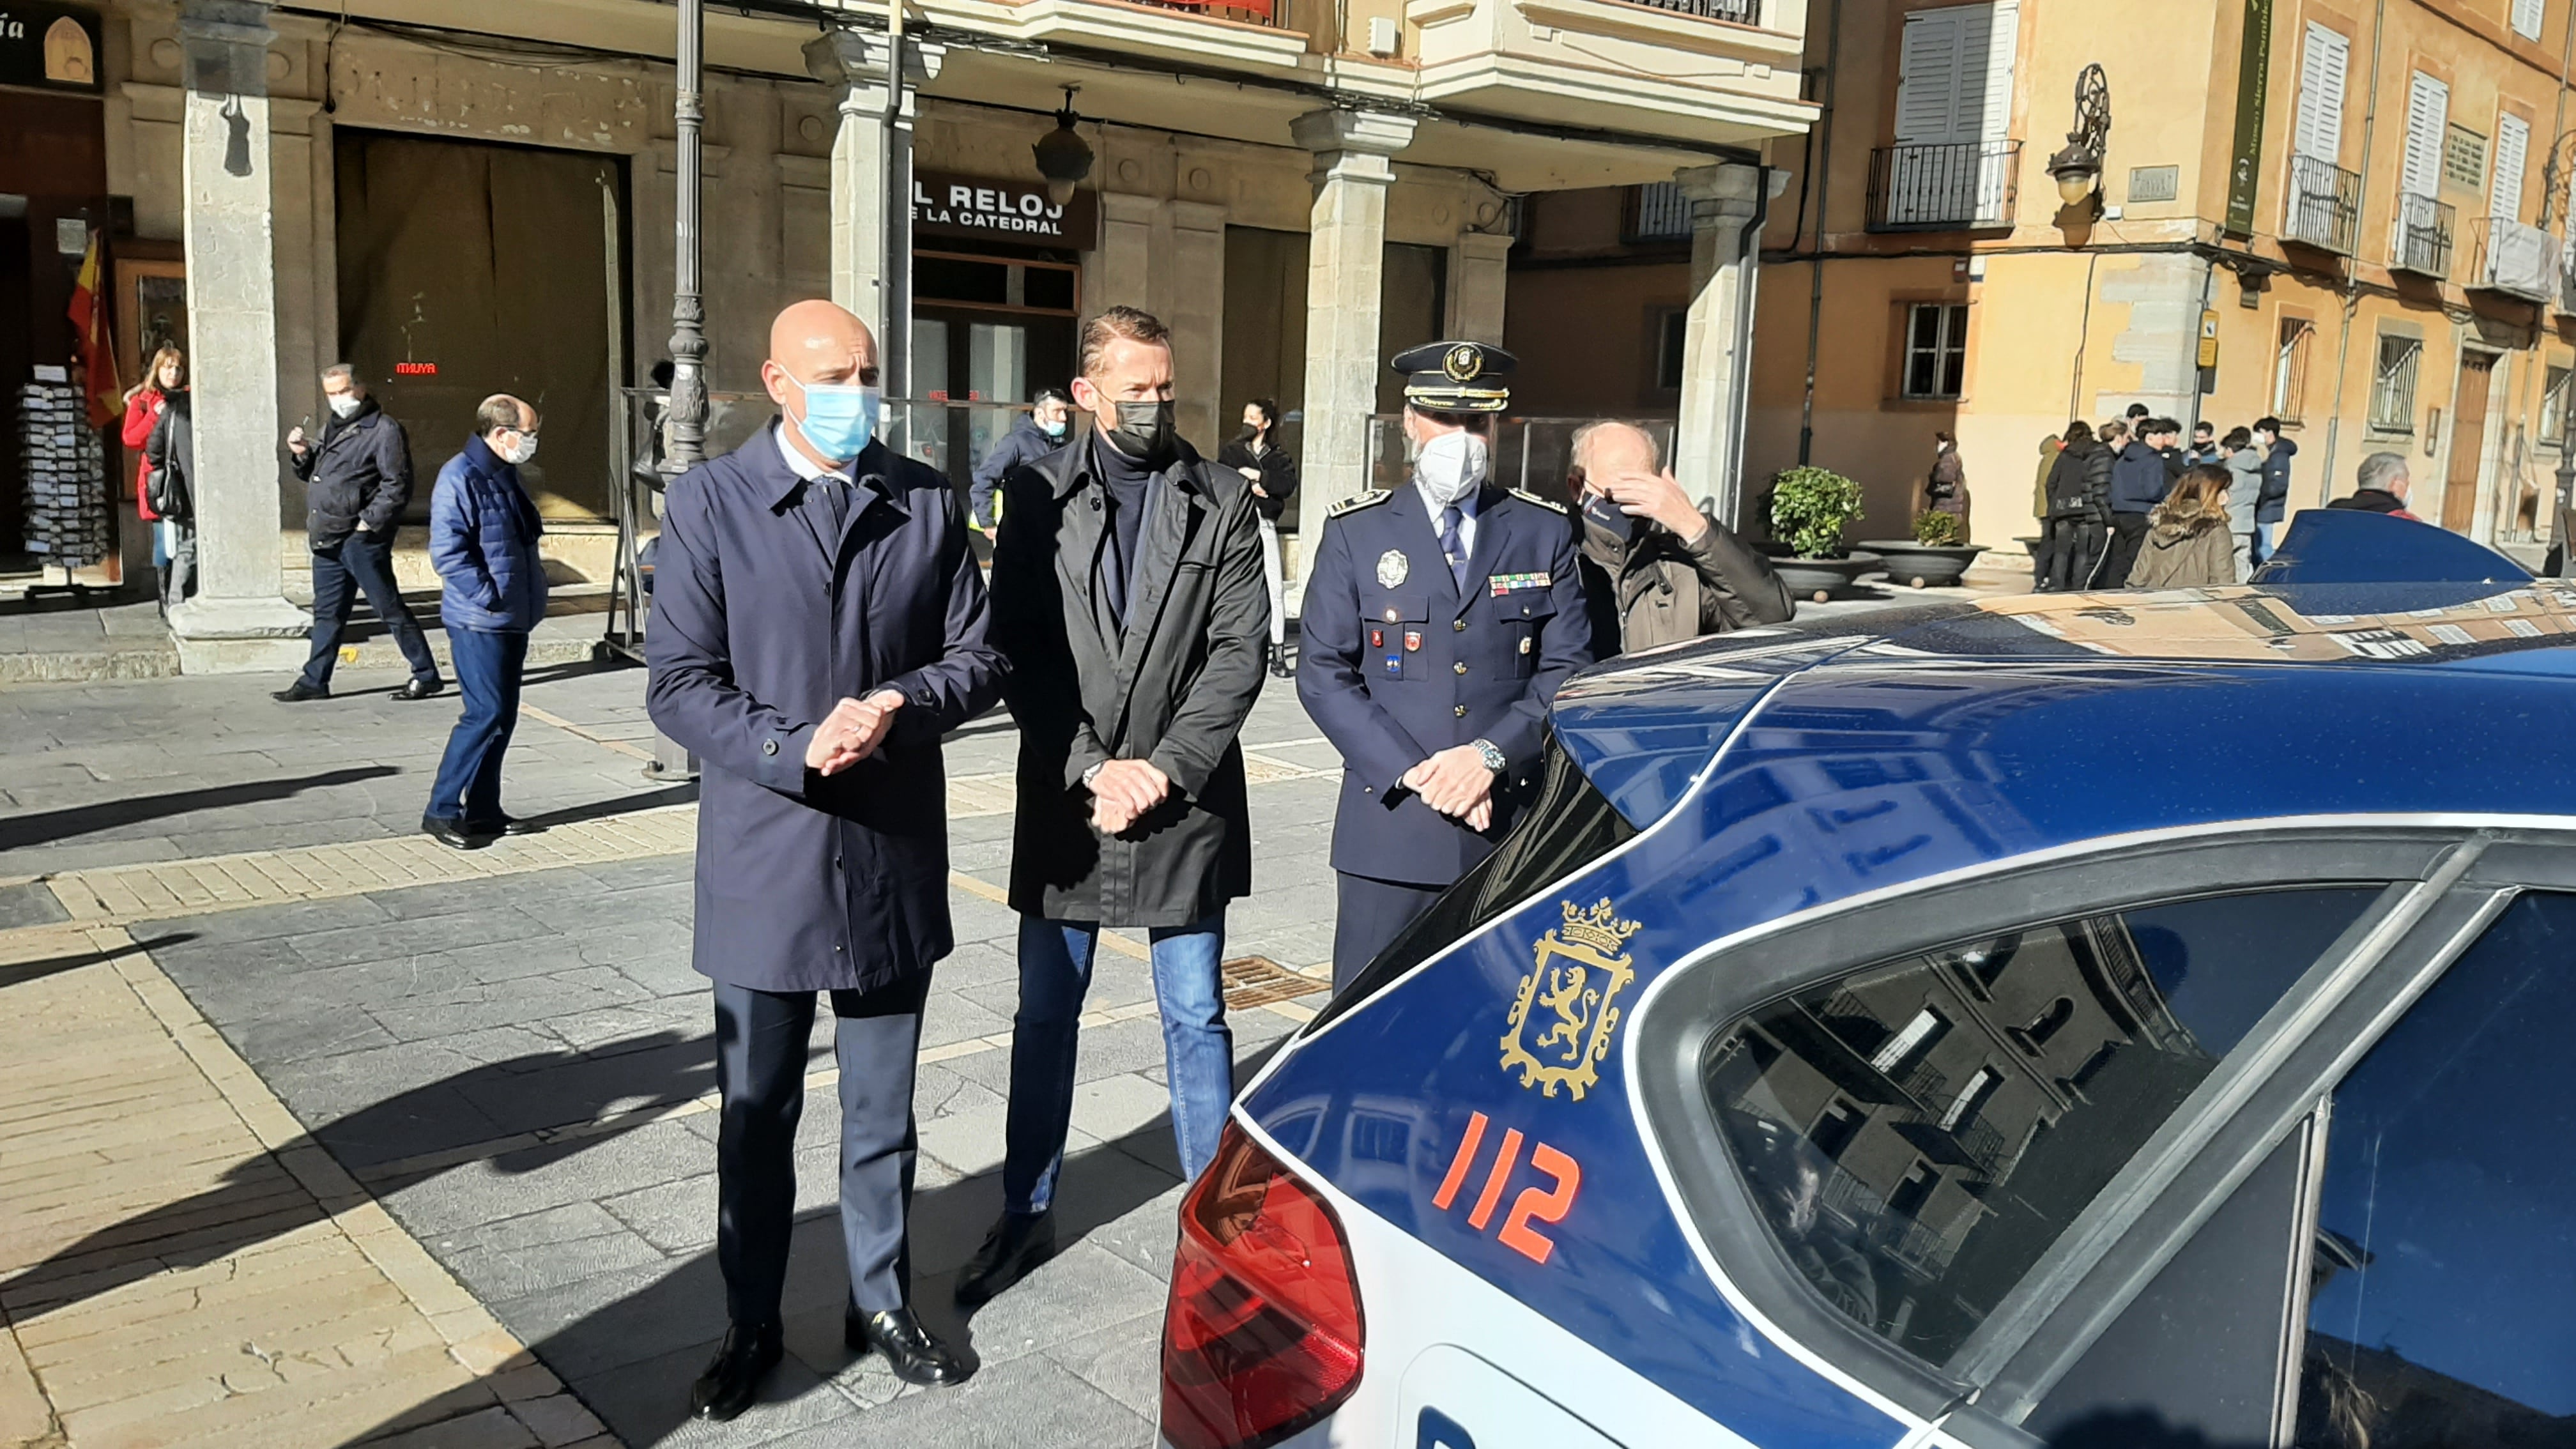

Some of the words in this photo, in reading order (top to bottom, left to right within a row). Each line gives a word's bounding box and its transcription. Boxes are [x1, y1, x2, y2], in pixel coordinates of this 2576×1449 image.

[0, 12, 24, 38] ía
[914, 181, 933, 204] L
[949, 185, 1063, 219] RELOJ
[912, 206, 918, 219] E
[927, 208, 951, 223] LA
[960, 211, 1062, 234] CATEDRAL
[1432, 1110, 1581, 1264] 112
